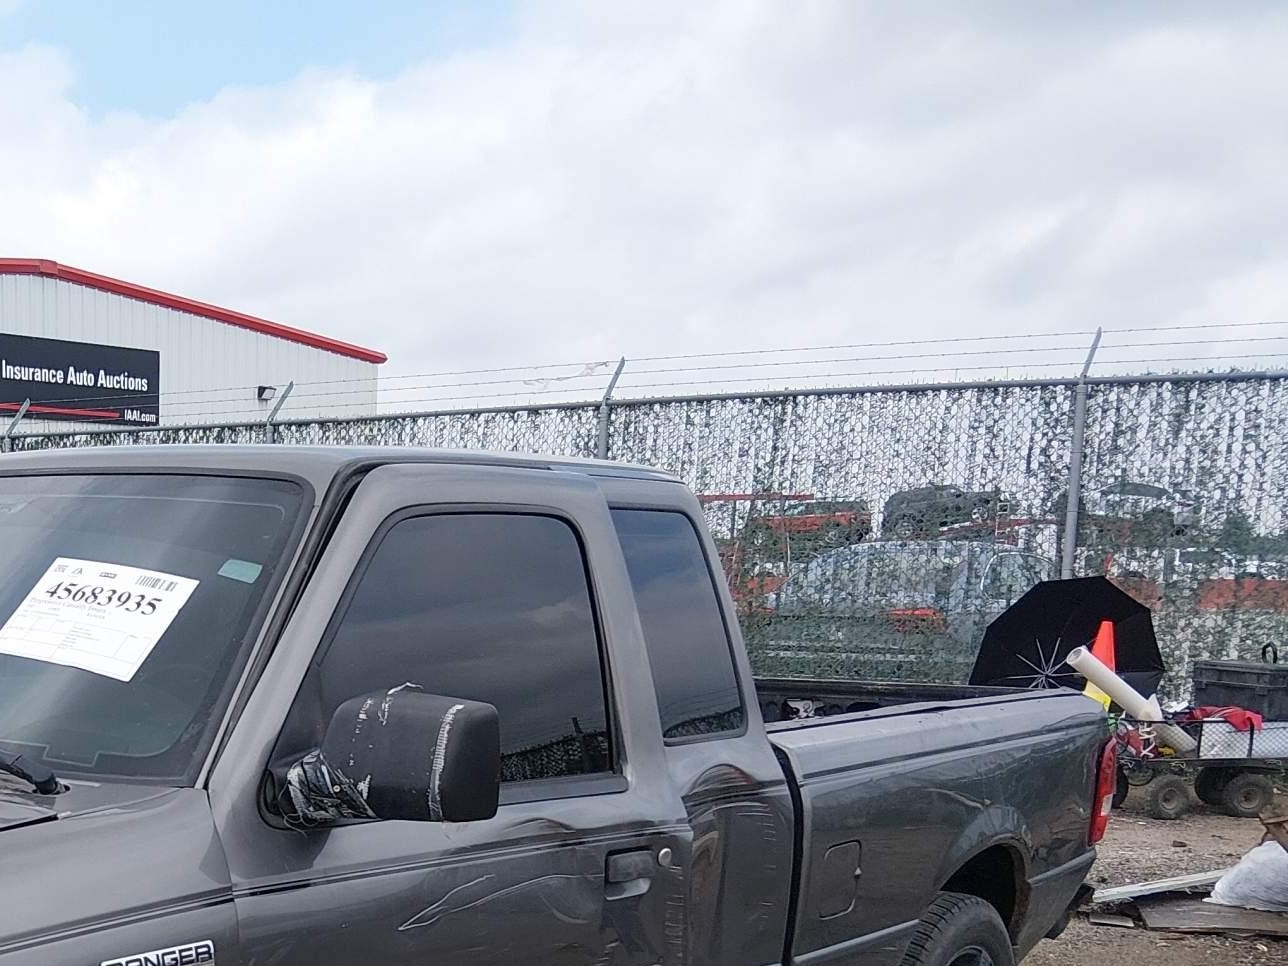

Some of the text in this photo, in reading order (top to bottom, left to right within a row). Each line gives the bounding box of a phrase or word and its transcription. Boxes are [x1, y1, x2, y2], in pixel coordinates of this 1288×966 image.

[1, 359, 148, 391] Insurance Auto Auctions
[124, 408, 156, 423] IAAI.com
[45, 580, 163, 616] 45683935
